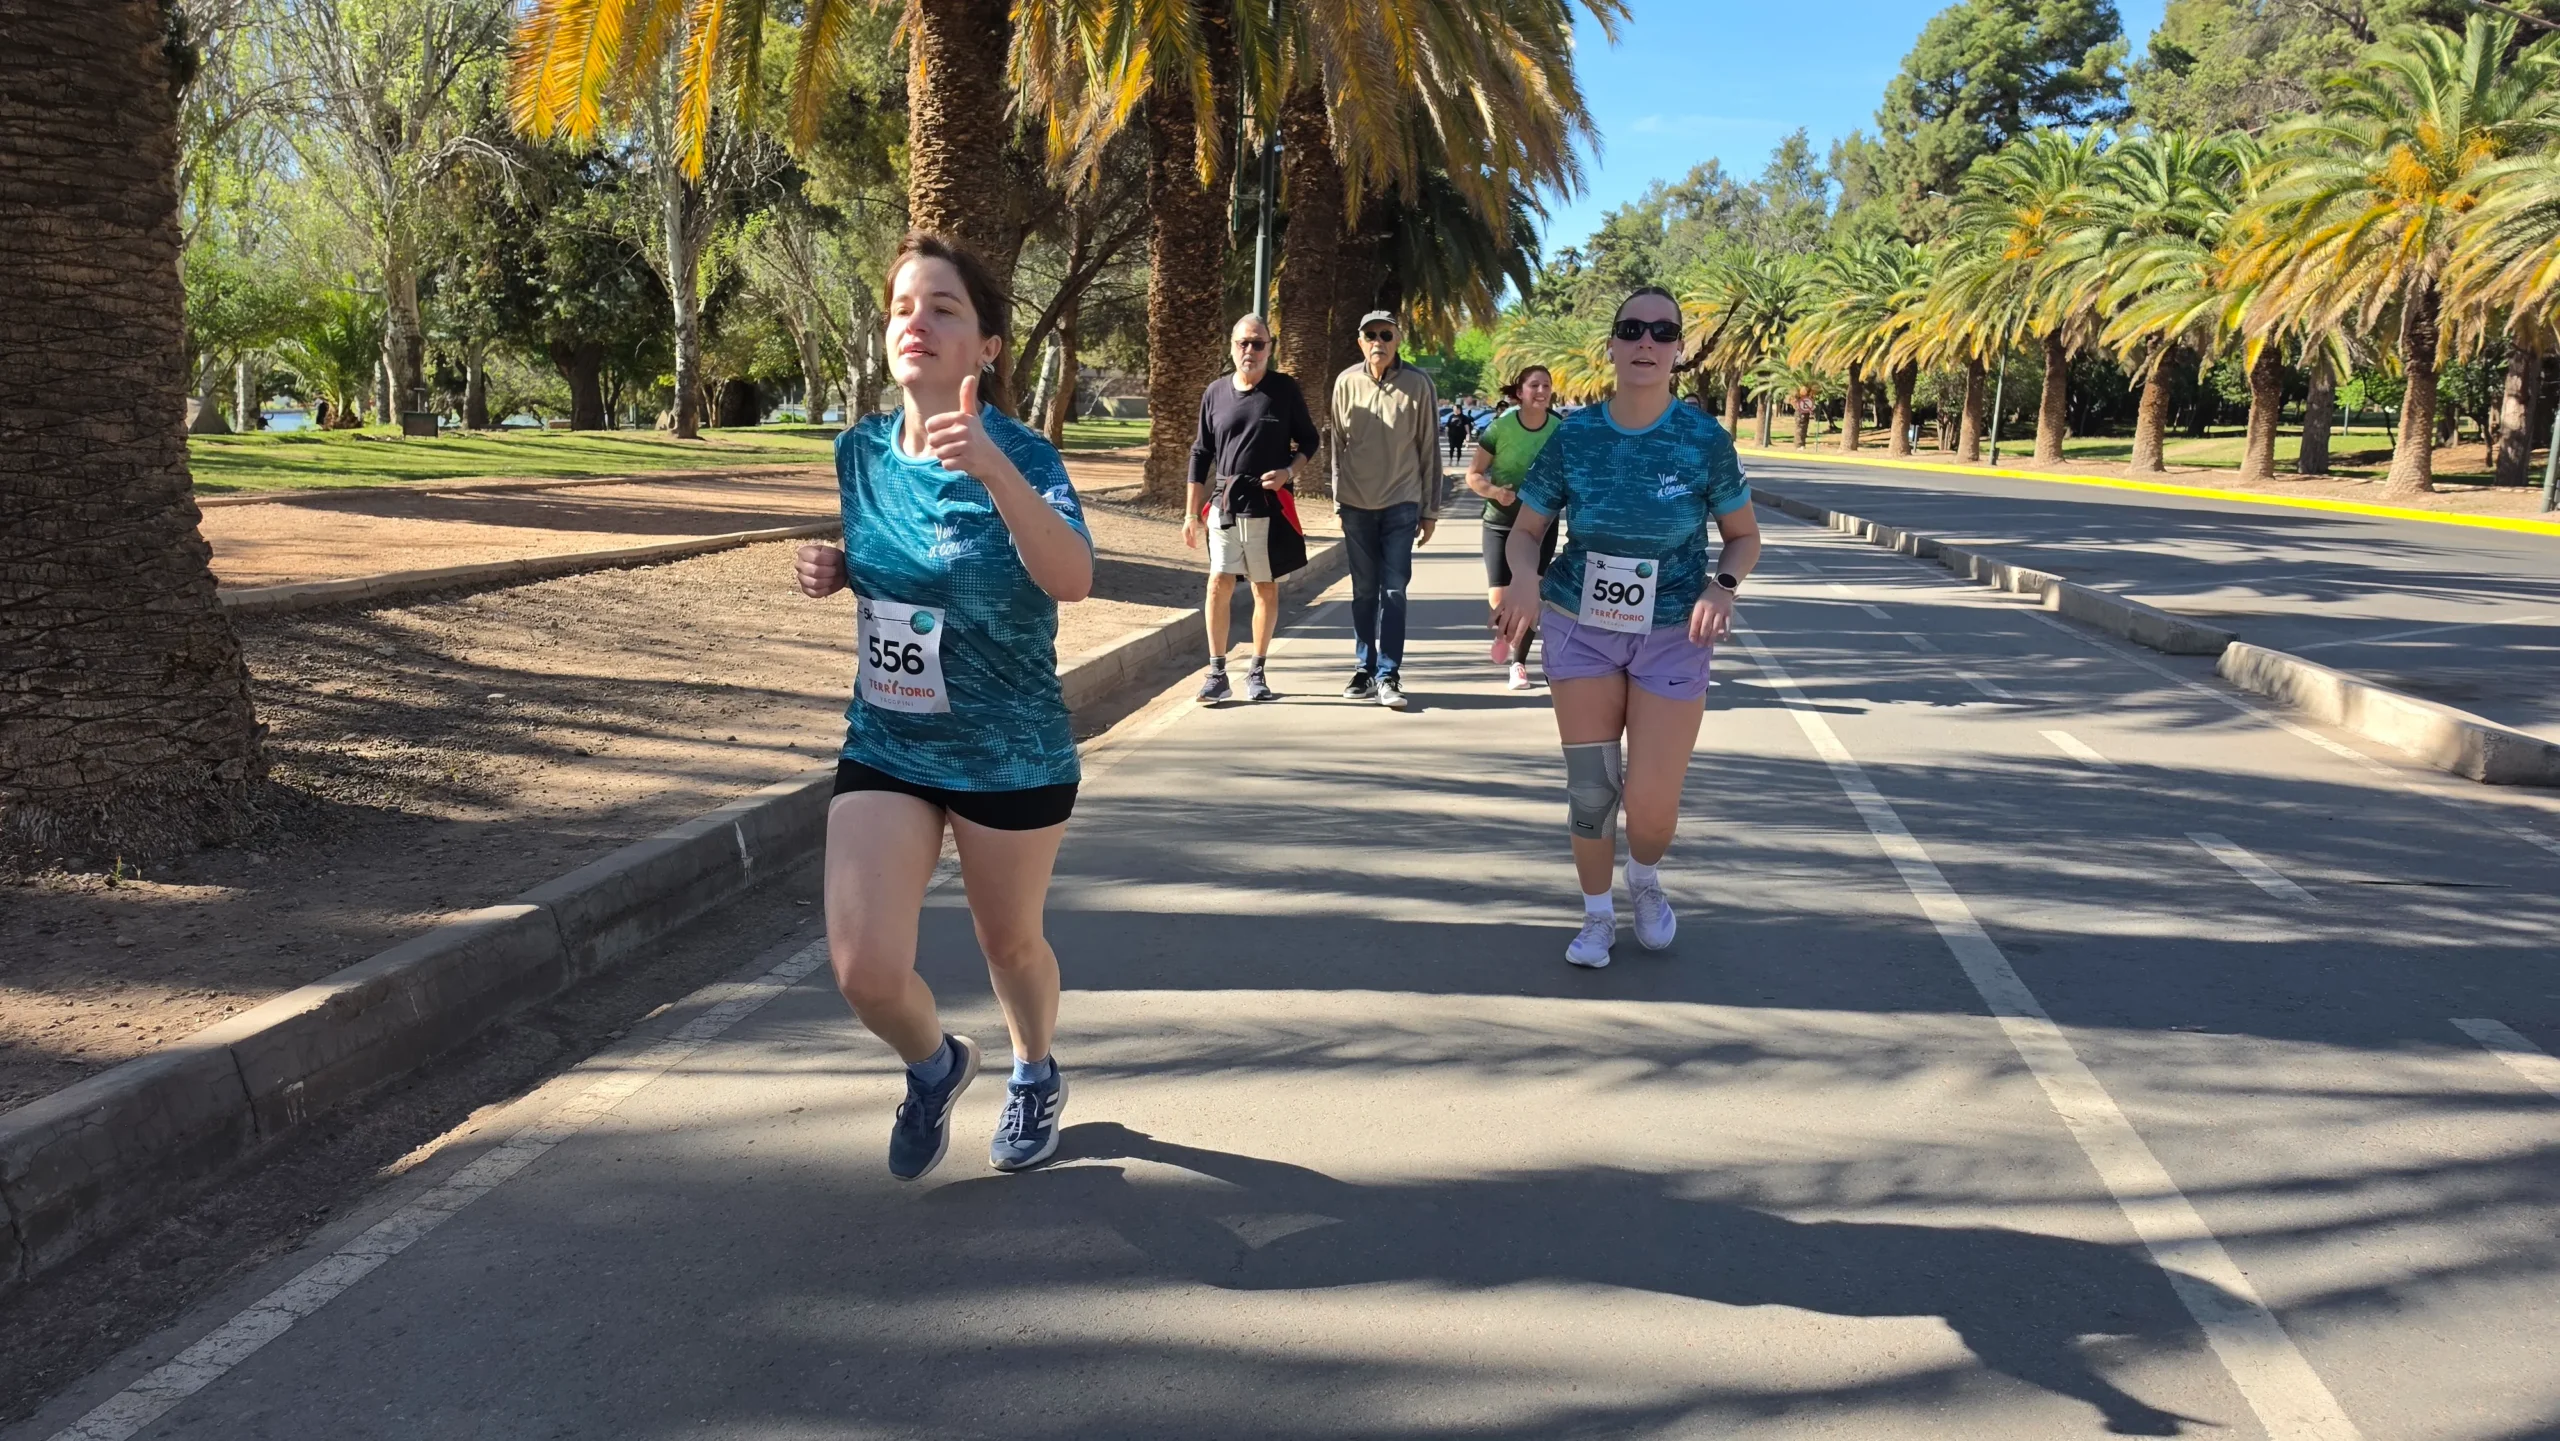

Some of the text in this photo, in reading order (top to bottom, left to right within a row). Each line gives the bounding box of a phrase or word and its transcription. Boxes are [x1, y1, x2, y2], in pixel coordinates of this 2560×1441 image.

[1657, 488, 1664, 498] a
[928, 545, 937, 558] a
[1592, 578, 1645, 606] 590
[1590, 608, 1645, 622] TERRITORIO
[869, 635, 925, 675] 556
[869, 679, 935, 698] TERRITORIO
